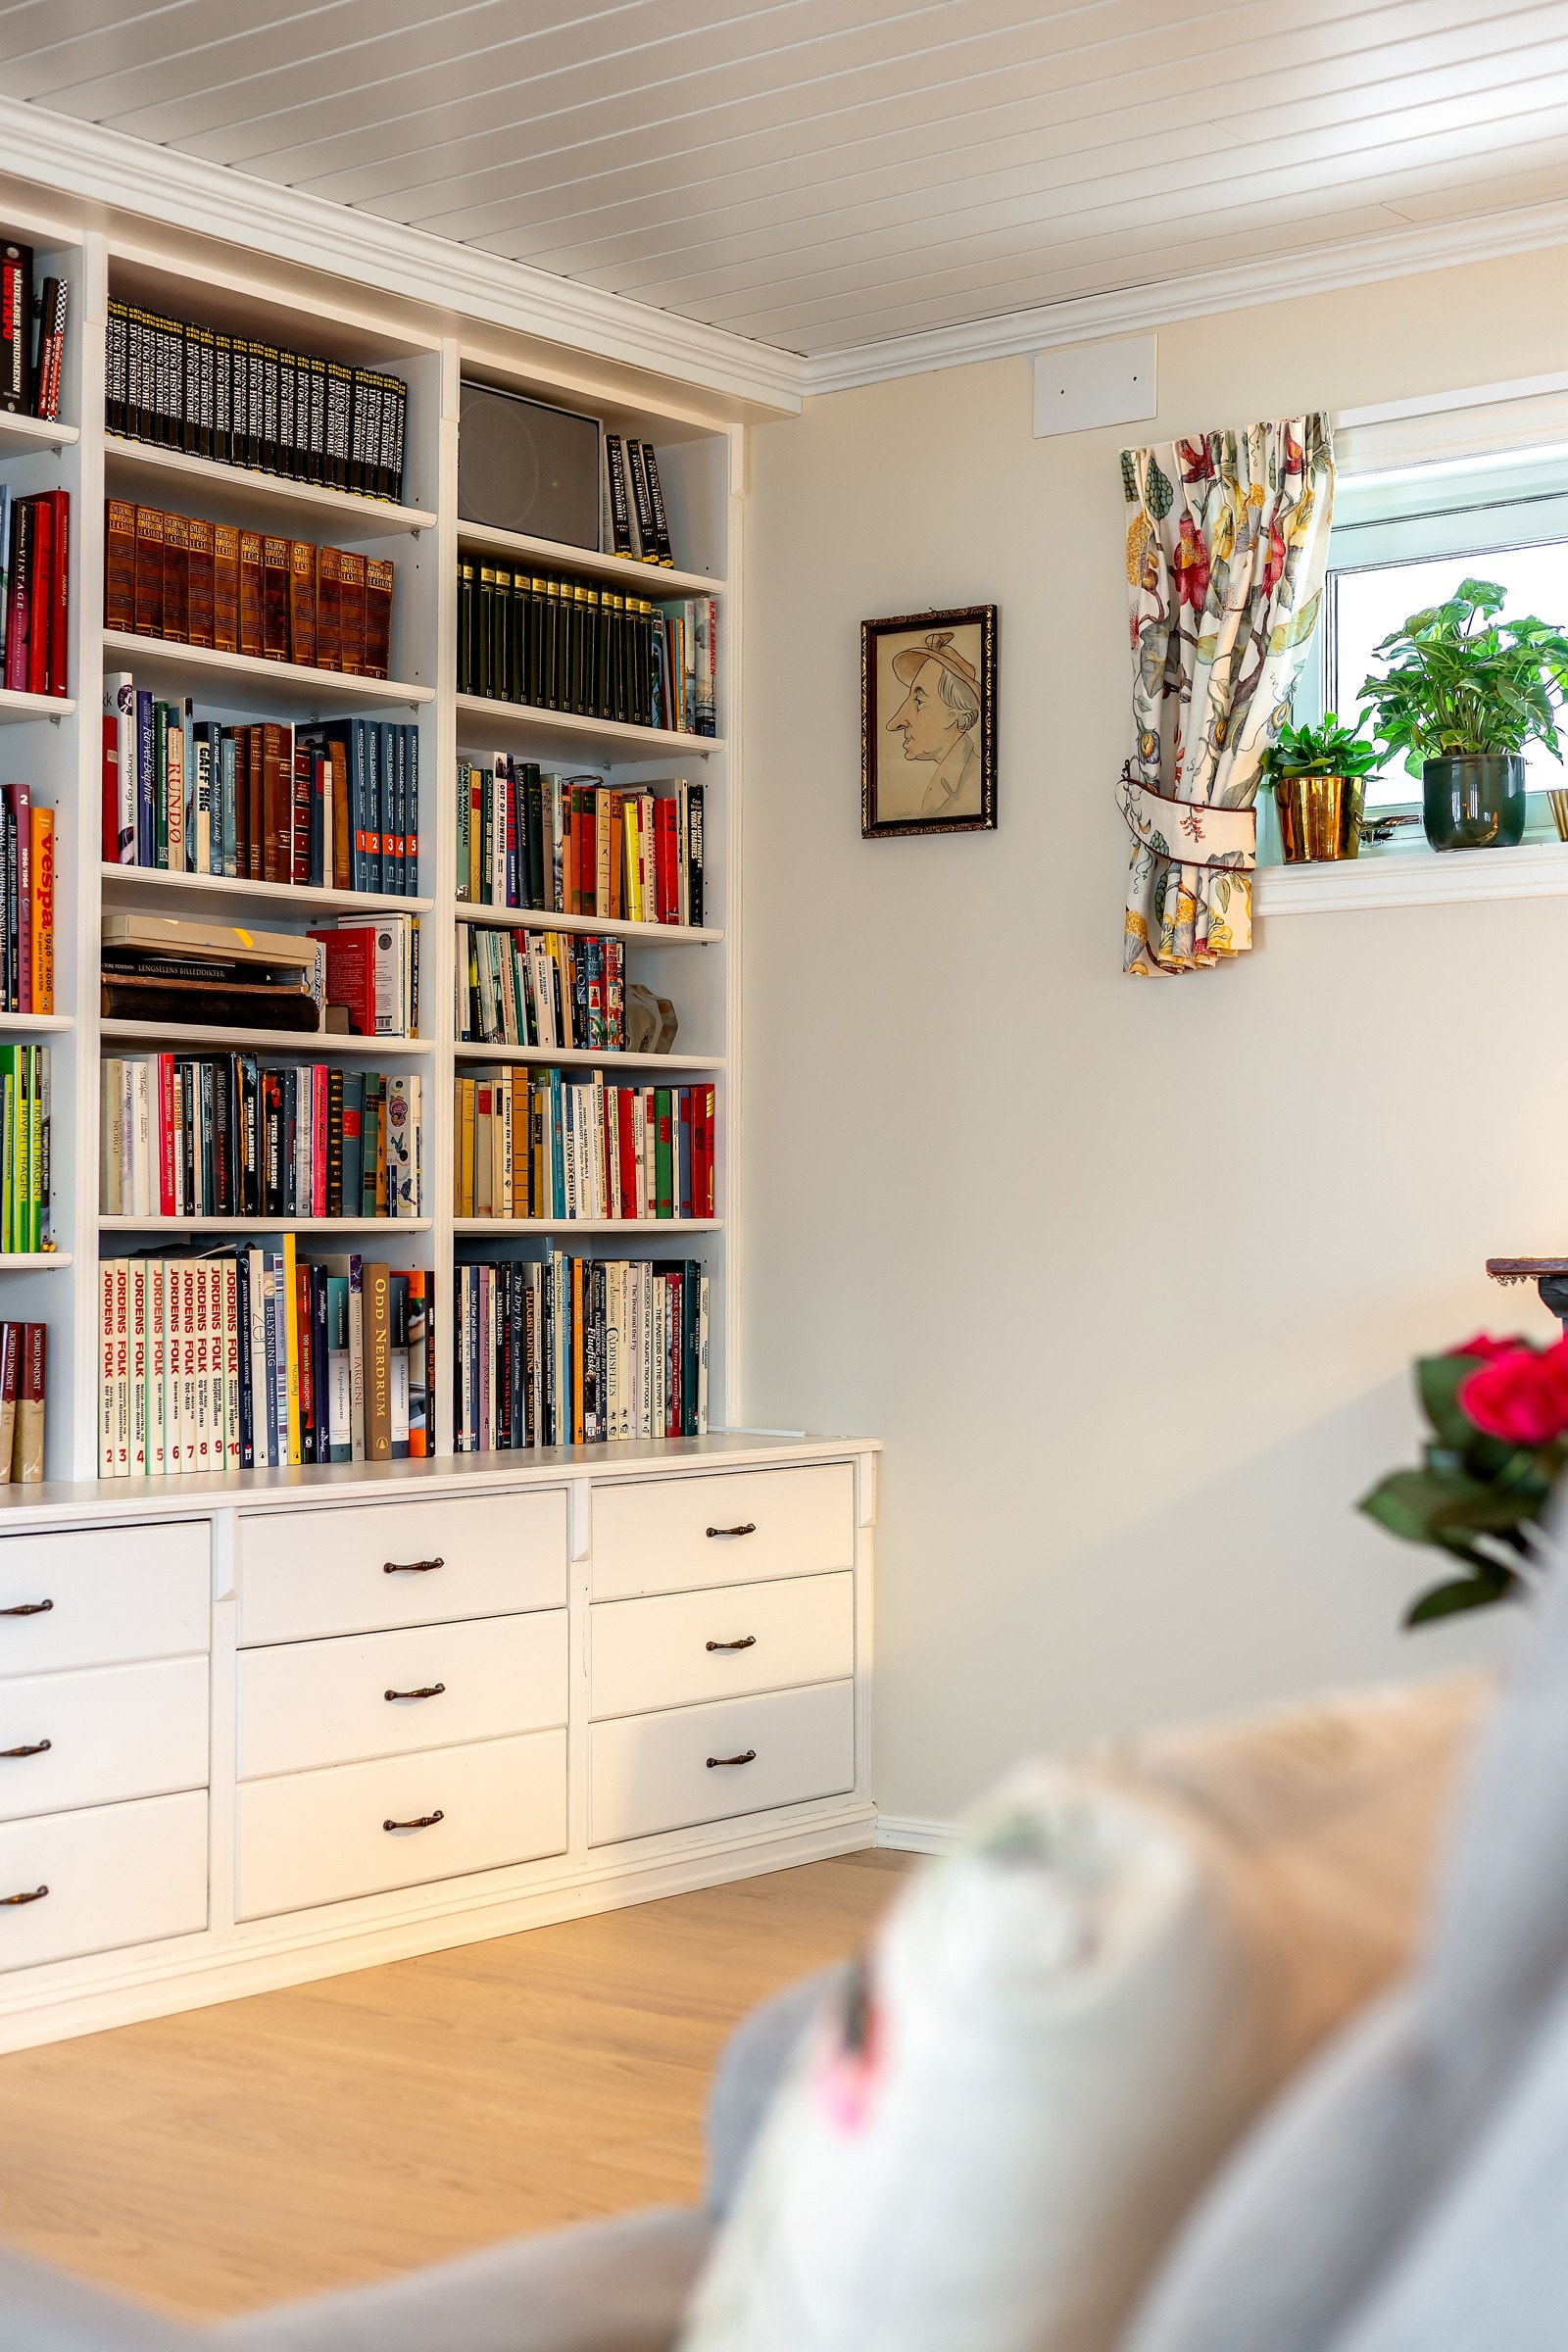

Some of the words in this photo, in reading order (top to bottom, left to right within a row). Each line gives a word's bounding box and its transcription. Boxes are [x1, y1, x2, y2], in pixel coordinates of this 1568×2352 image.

[3, 267, 15, 339] GESTAPO
[13, 269, 24, 325] NÅDELØSE
[114, 335, 120, 349] OG
[233, 369, 240, 384] OG
[17, 550, 25, 610] VINTAGE
[199, 747, 210, 781] GAFF
[21, 795, 27, 805] 2
[126, 789, 133, 801] og
[169, 762, 181, 843] RUNDØ
[199, 786, 210, 811] RIG
[500, 804, 505, 812] OF
[372, 837, 378, 849] 2
[388, 839, 393, 851] 3
[398, 842, 404, 853] 4
[412, 840, 416, 851] 5
[37, 833, 53, 929] vespa
[217, 1071, 225, 1089] MEG
[506, 1129, 511, 1140] in
[566, 1130, 575, 1210] HAVNEGUIDE
[118, 1269, 126, 1333] JORDENS
[184, 1270, 193, 1333] JORDENS
[212, 1267, 220, 1330] JORDENS
[227, 1269, 236, 1332] JORDENS
[267, 1306, 275, 1366] BELYSNING
[513, 1317, 521, 1331] Fly
[118, 1341, 126, 1376] FOLK
[198, 1338, 207, 1373] FOLK
[213, 1337, 221, 1372] FOLK
[227, 1339, 236, 1373] FOLK
[657, 1356, 662, 1366] ON
[6, 1359, 15, 1391] UNDSET
[106, 1449, 113, 1462] 2
[137, 1450, 144, 1463] 4
[187, 1446, 194, 1458] 7
[216, 1441, 221, 1453] 9
